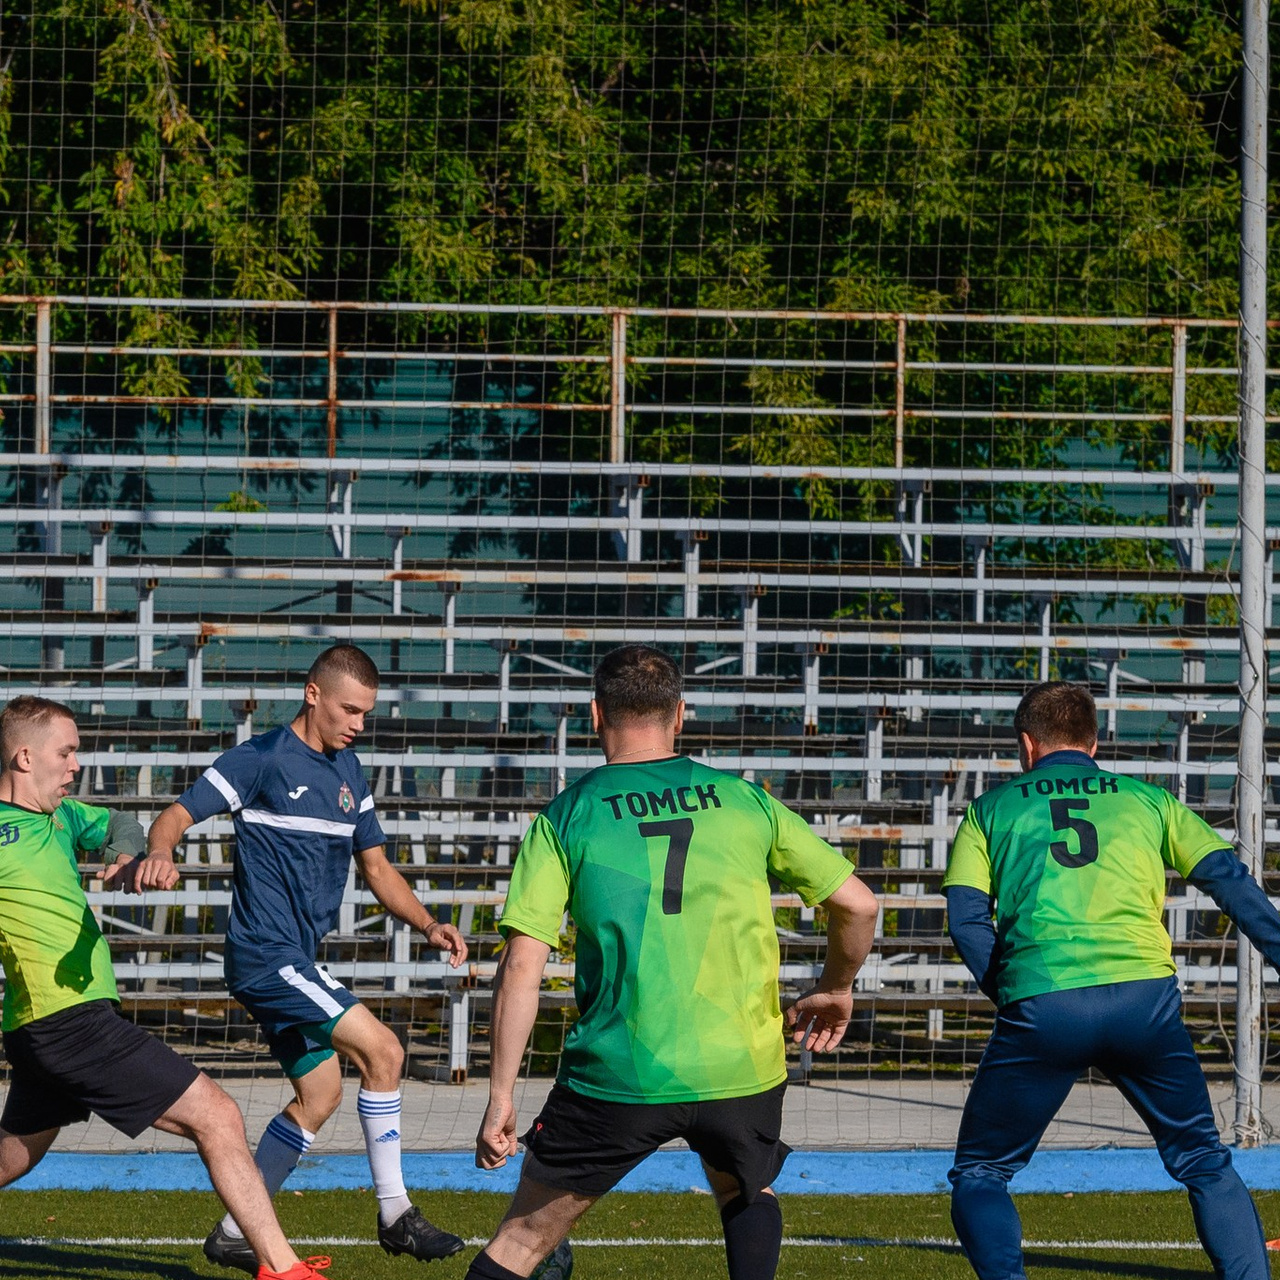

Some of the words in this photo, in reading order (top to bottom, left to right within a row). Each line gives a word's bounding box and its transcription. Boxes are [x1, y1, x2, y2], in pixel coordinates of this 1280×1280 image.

[601, 784, 722, 820] ТОМСК
[1014, 777, 1118, 798] ТОМСК
[1049, 798, 1098, 868] 5
[638, 817, 694, 915] 7
